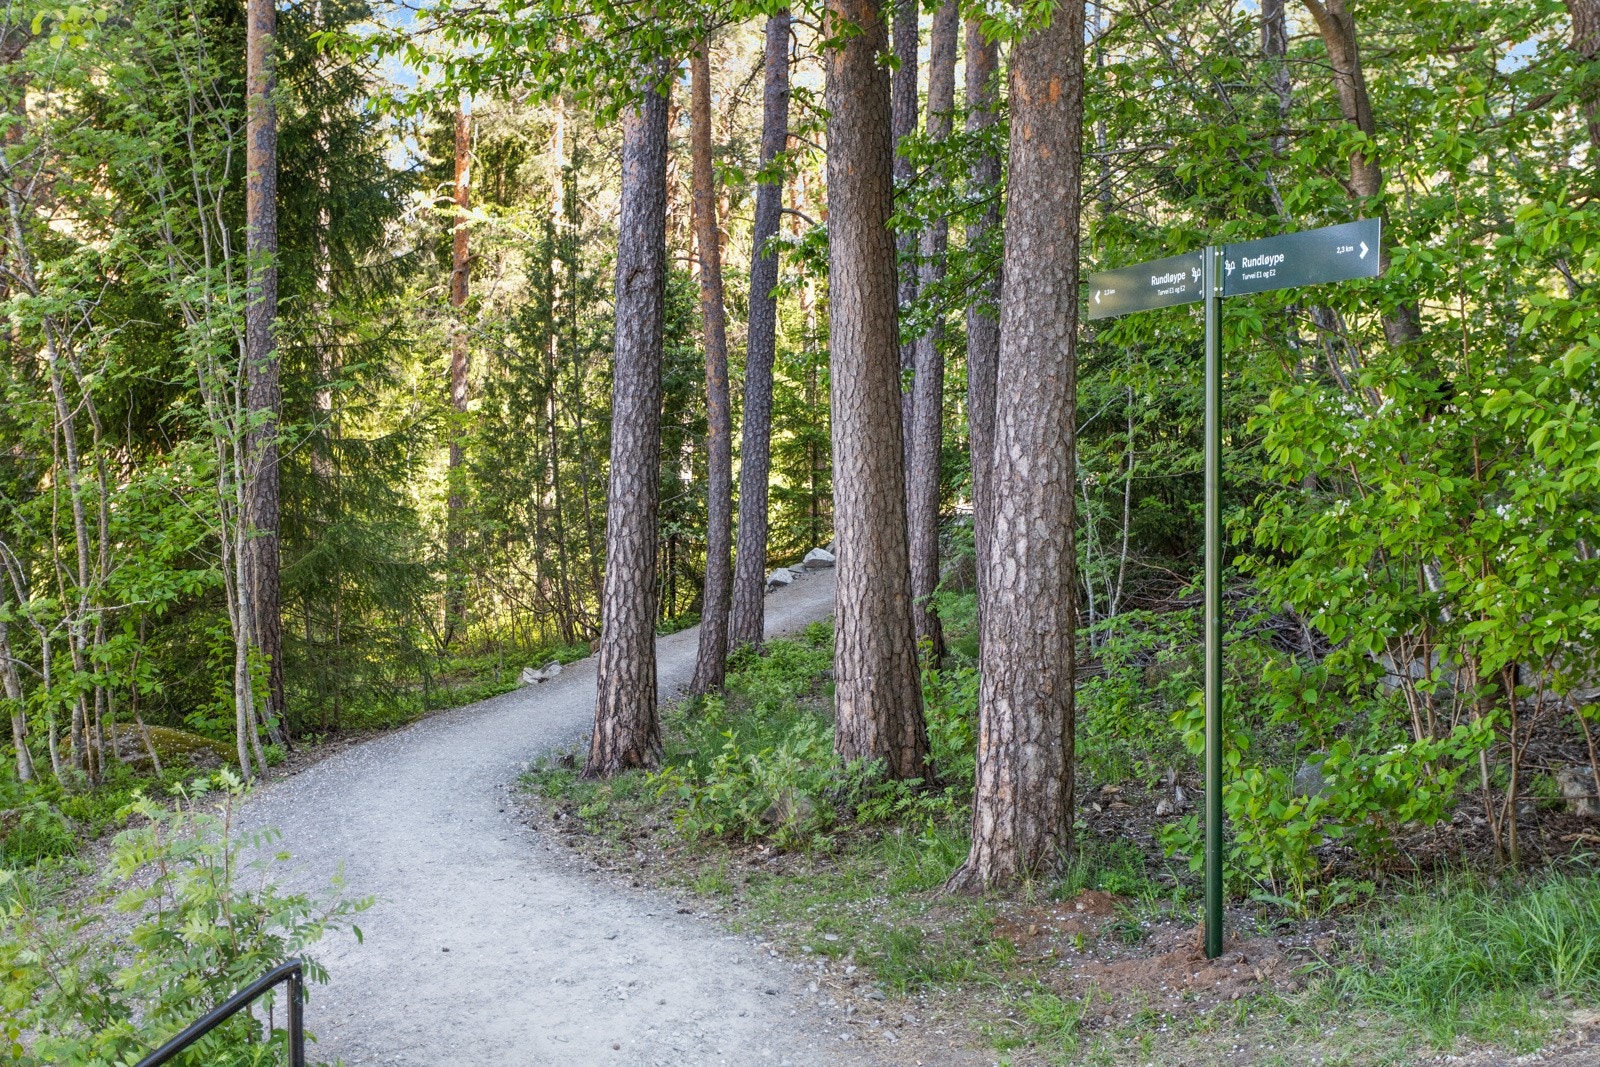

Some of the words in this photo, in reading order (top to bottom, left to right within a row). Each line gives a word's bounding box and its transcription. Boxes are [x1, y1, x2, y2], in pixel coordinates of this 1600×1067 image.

[1336, 245, 1345, 254] 2,3
[1242, 253, 1285, 268] Rundløype
[1151, 271, 1186, 286] Rundløype
[1242, 271, 1256, 280] Turvei
[1269, 268, 1276, 277] E2
